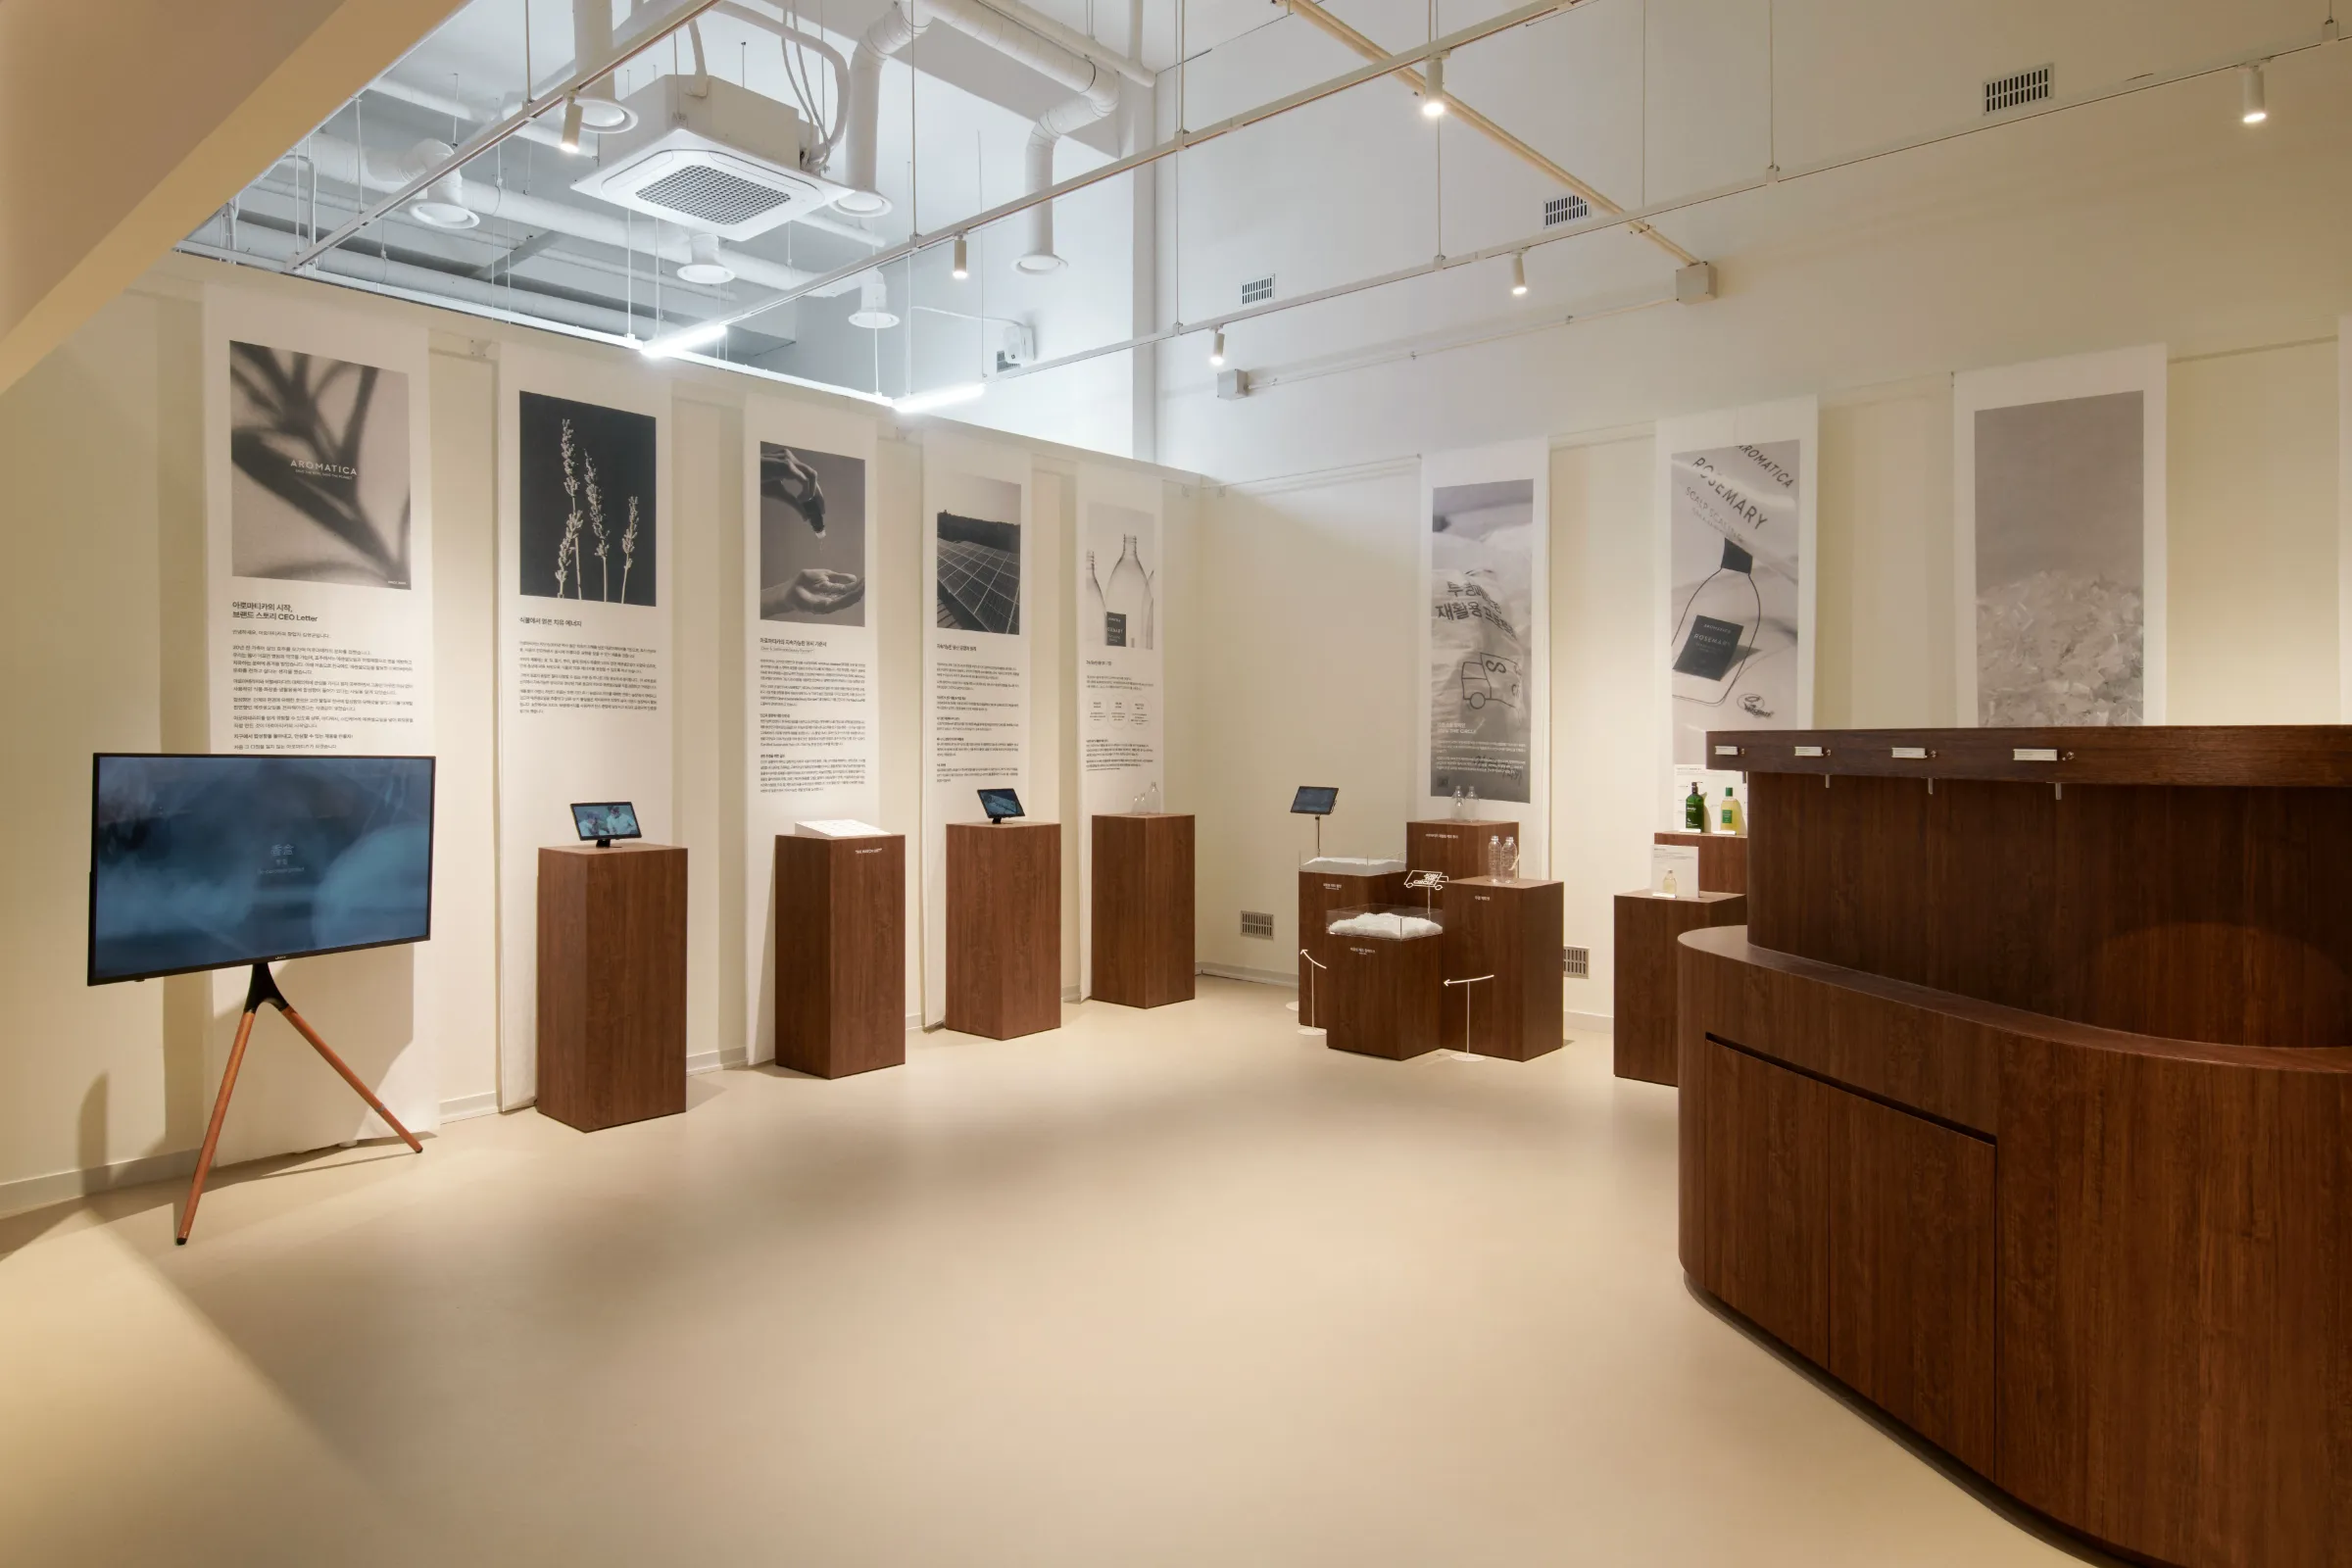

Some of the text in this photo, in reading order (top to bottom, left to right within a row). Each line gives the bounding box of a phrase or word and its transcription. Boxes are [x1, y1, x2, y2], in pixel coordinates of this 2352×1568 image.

[290, 460, 358, 475] AROMATICA
[232, 601, 293, 612] 아로마티카의 시작,
[1435, 602, 1482, 620] 재활용
